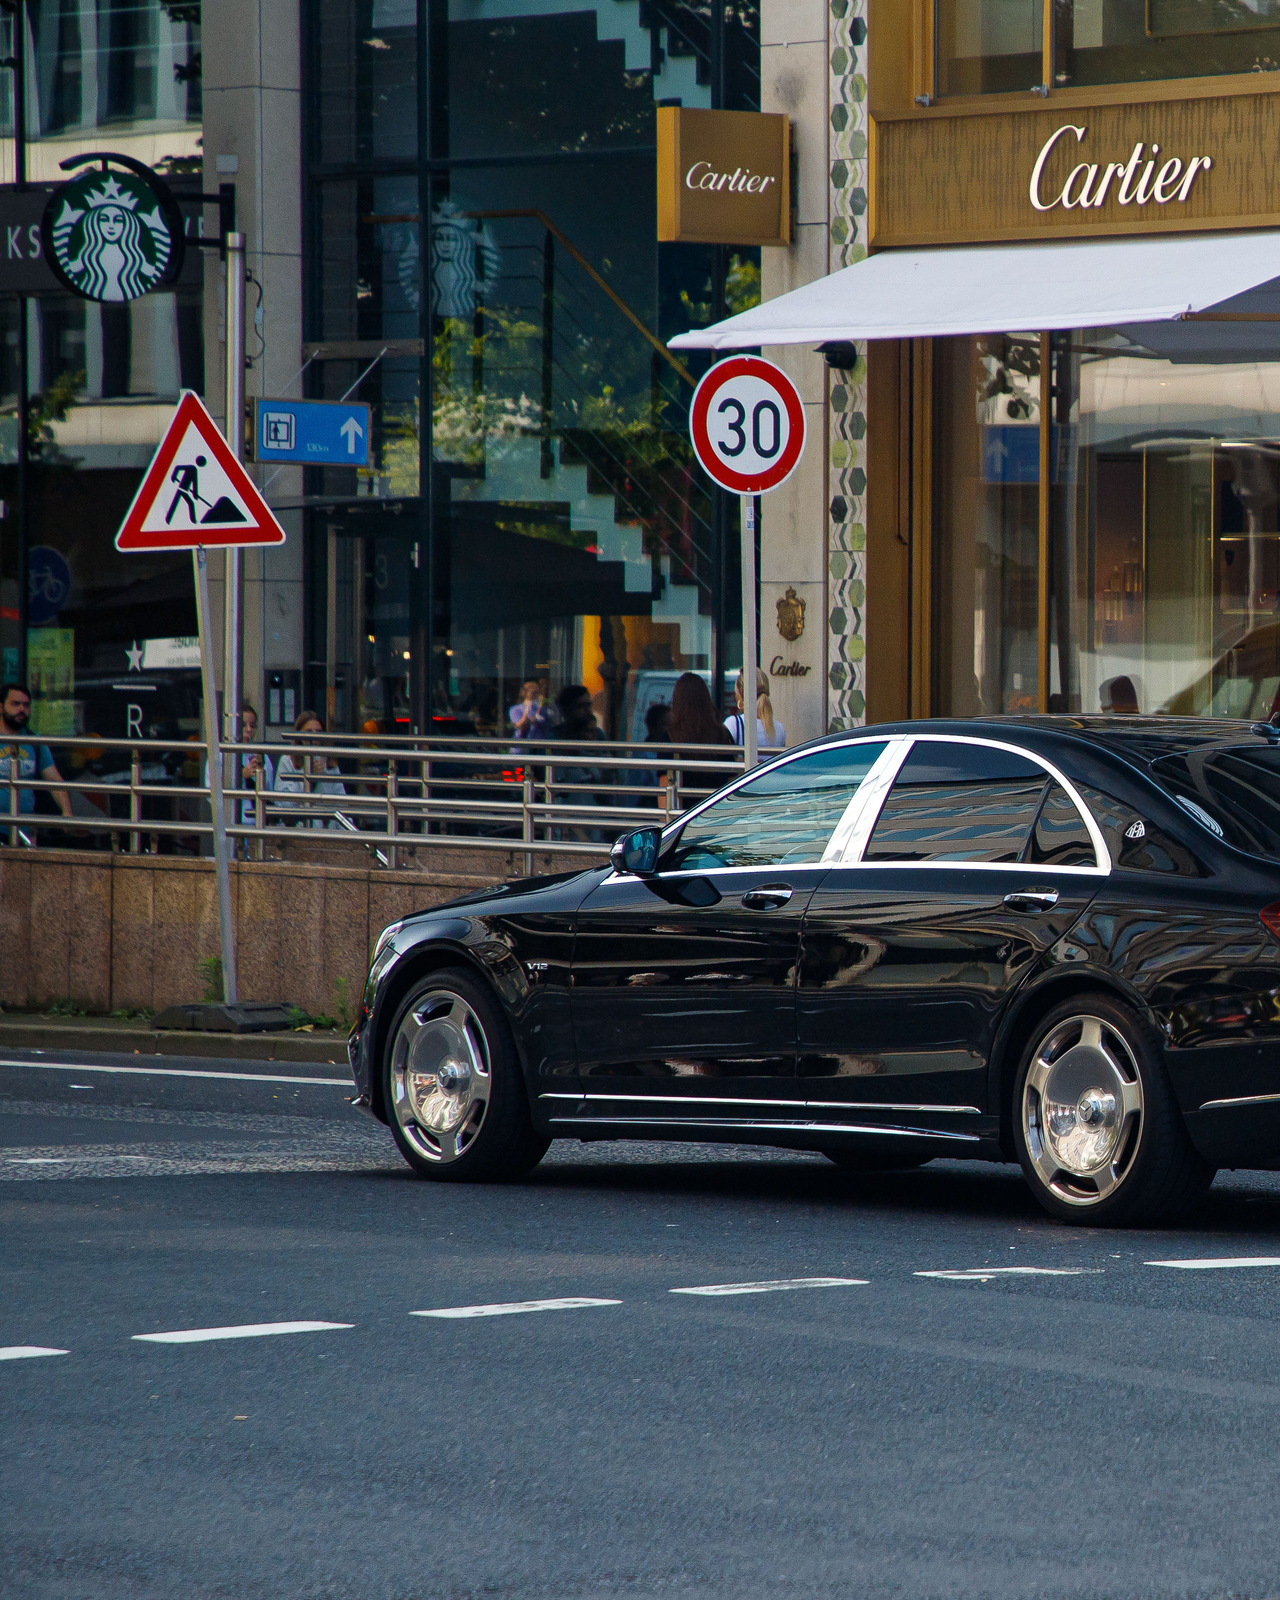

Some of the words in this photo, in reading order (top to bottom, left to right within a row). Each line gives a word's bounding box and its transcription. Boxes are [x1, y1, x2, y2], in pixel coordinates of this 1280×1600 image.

[685, 160, 775, 195] Cartier
[1029, 124, 1211, 211] Cartier
[717, 397, 781, 459] 30
[769, 655, 811, 677] Cartier
[127, 704, 143, 738] R
[526, 962, 549, 970] V12
